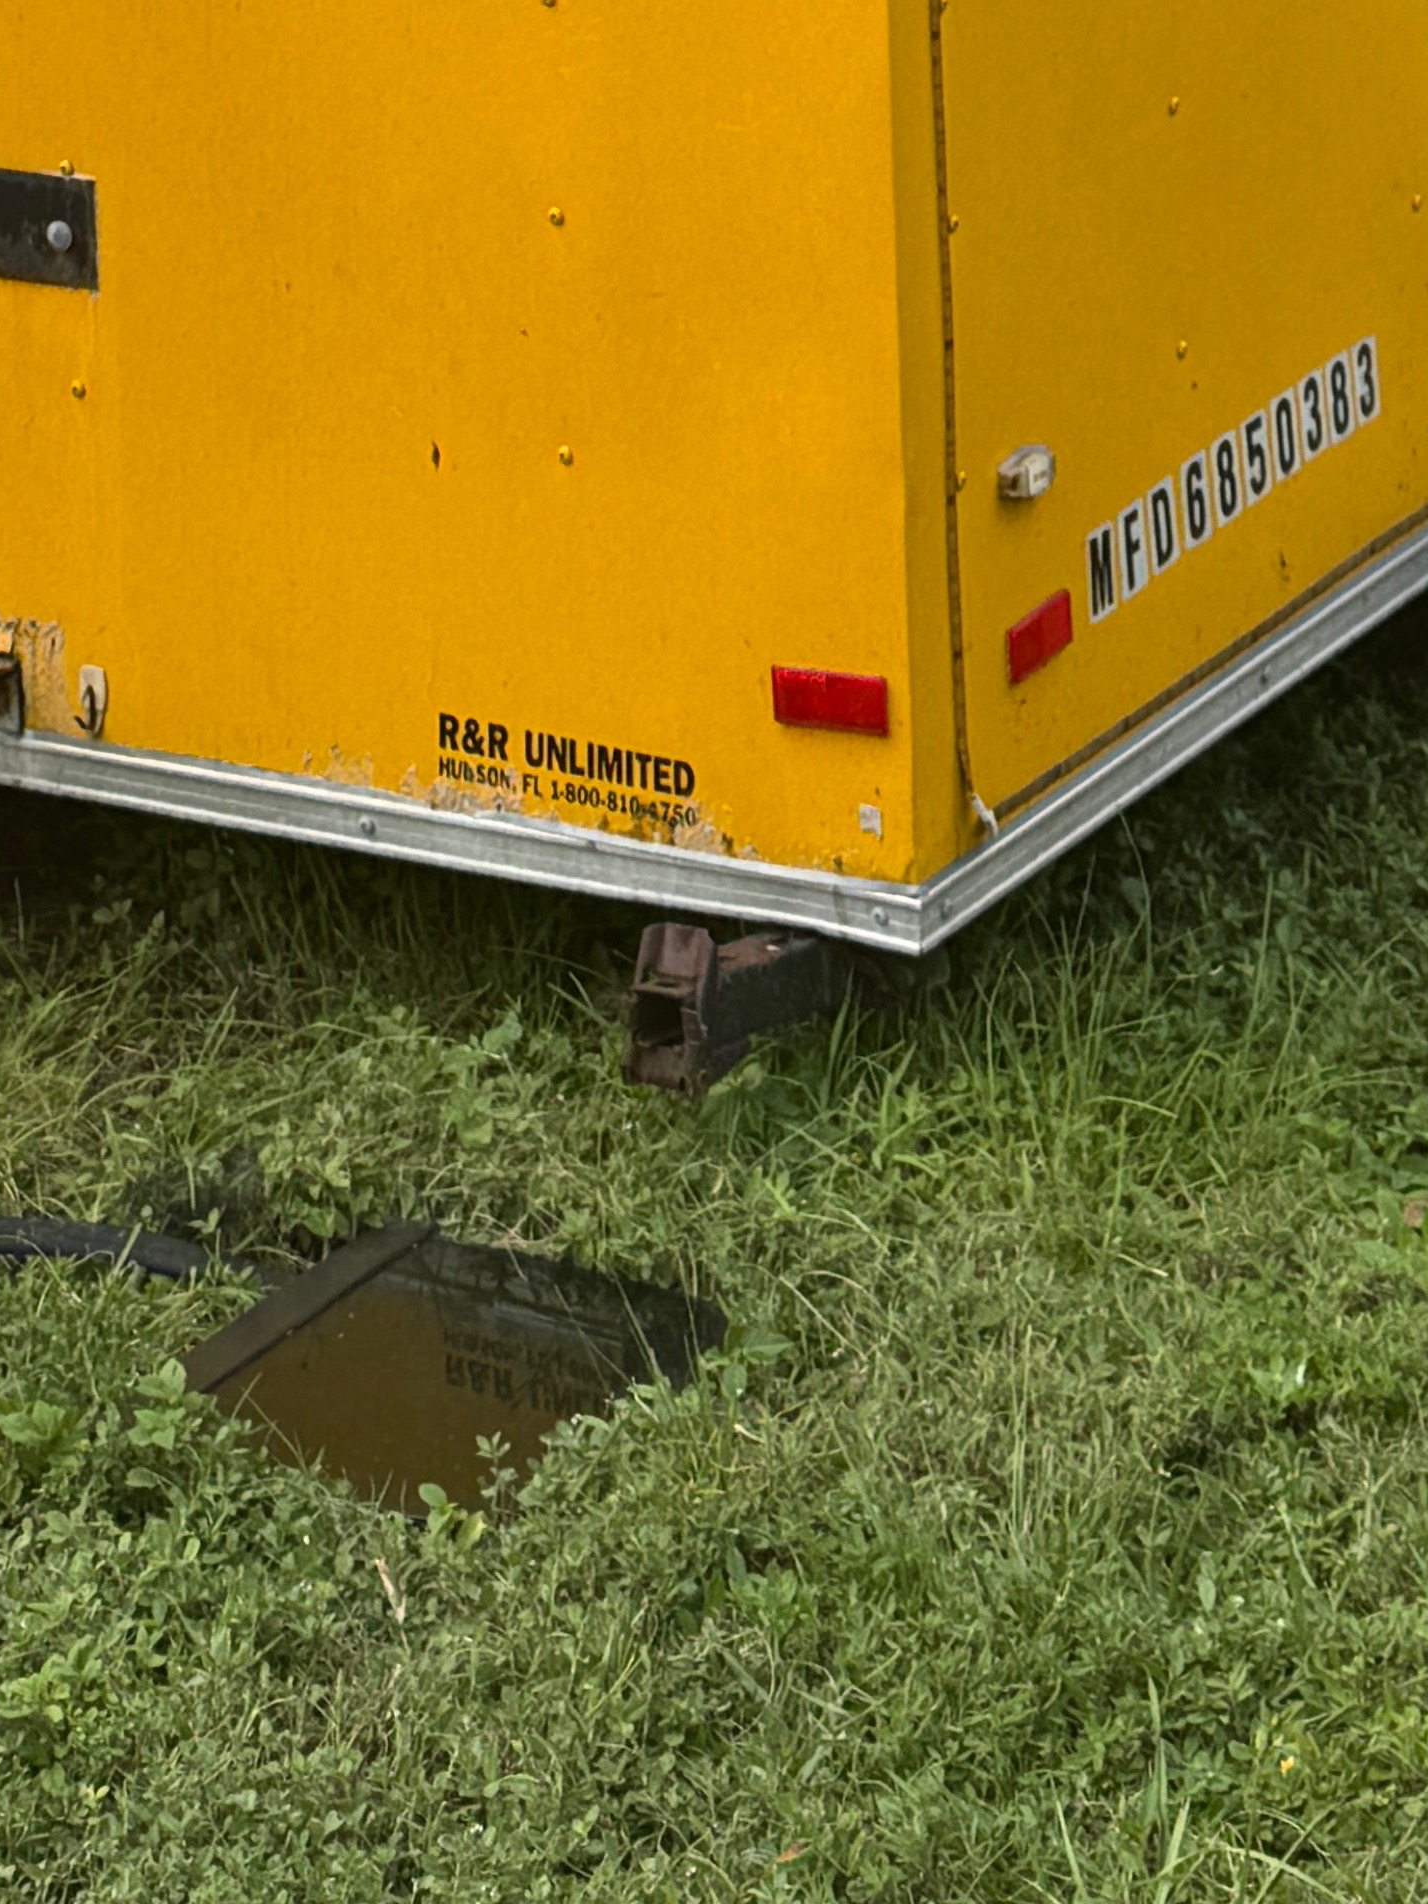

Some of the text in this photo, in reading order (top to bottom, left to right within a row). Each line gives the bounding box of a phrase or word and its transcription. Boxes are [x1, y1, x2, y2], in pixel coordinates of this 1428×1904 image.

[1087, 341, 1376, 617] MFD6850383
[438, 711, 697, 798] R&R UNLIMITED
[522, 774, 543, 799] FL
